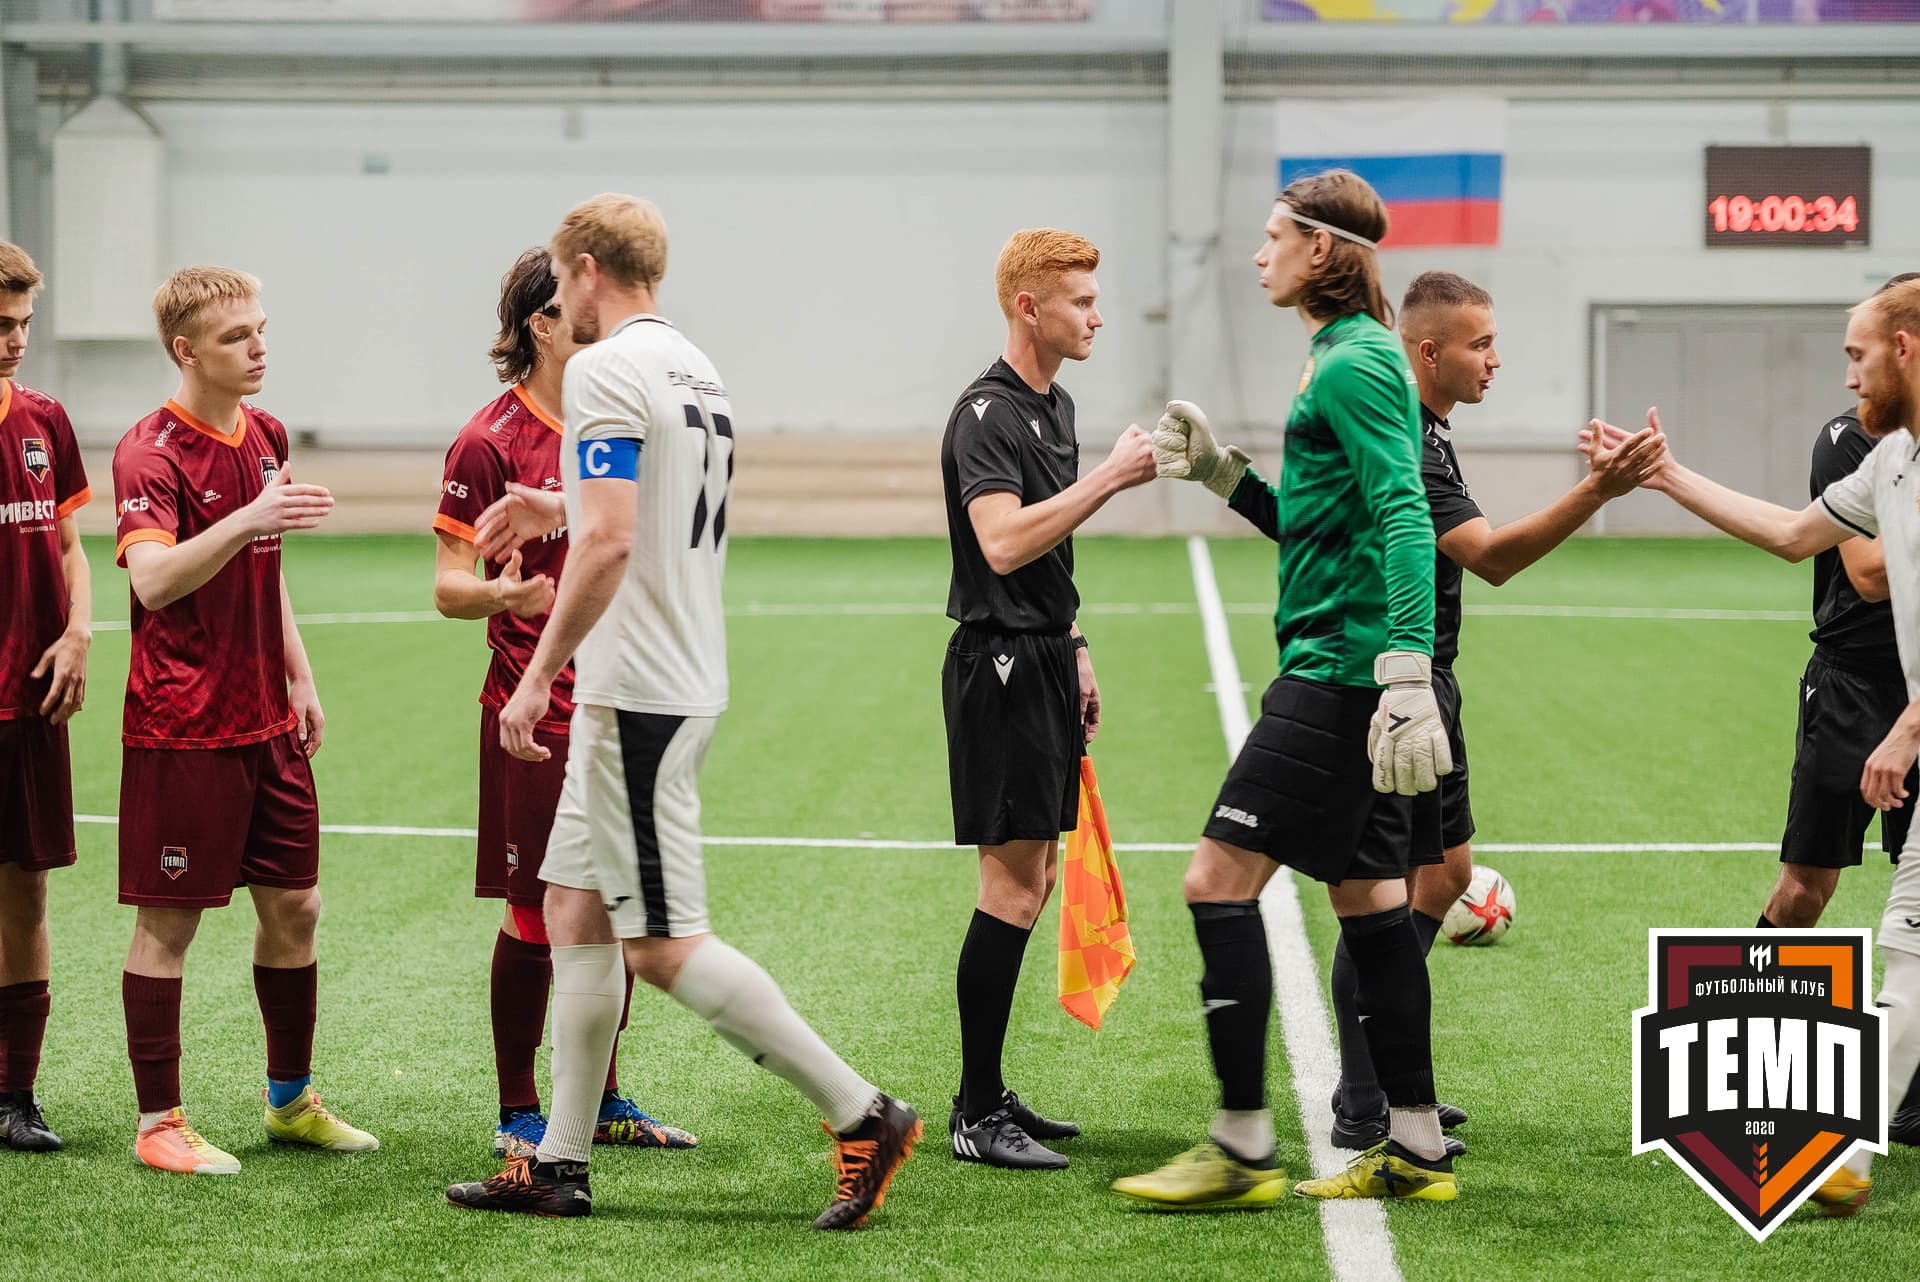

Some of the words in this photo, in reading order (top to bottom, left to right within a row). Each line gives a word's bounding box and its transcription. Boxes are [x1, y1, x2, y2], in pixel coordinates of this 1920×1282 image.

[1708, 194, 1859, 232] 19:00:34
[586, 441, 612, 476] C
[164, 855, 185, 868] ТЕМП
